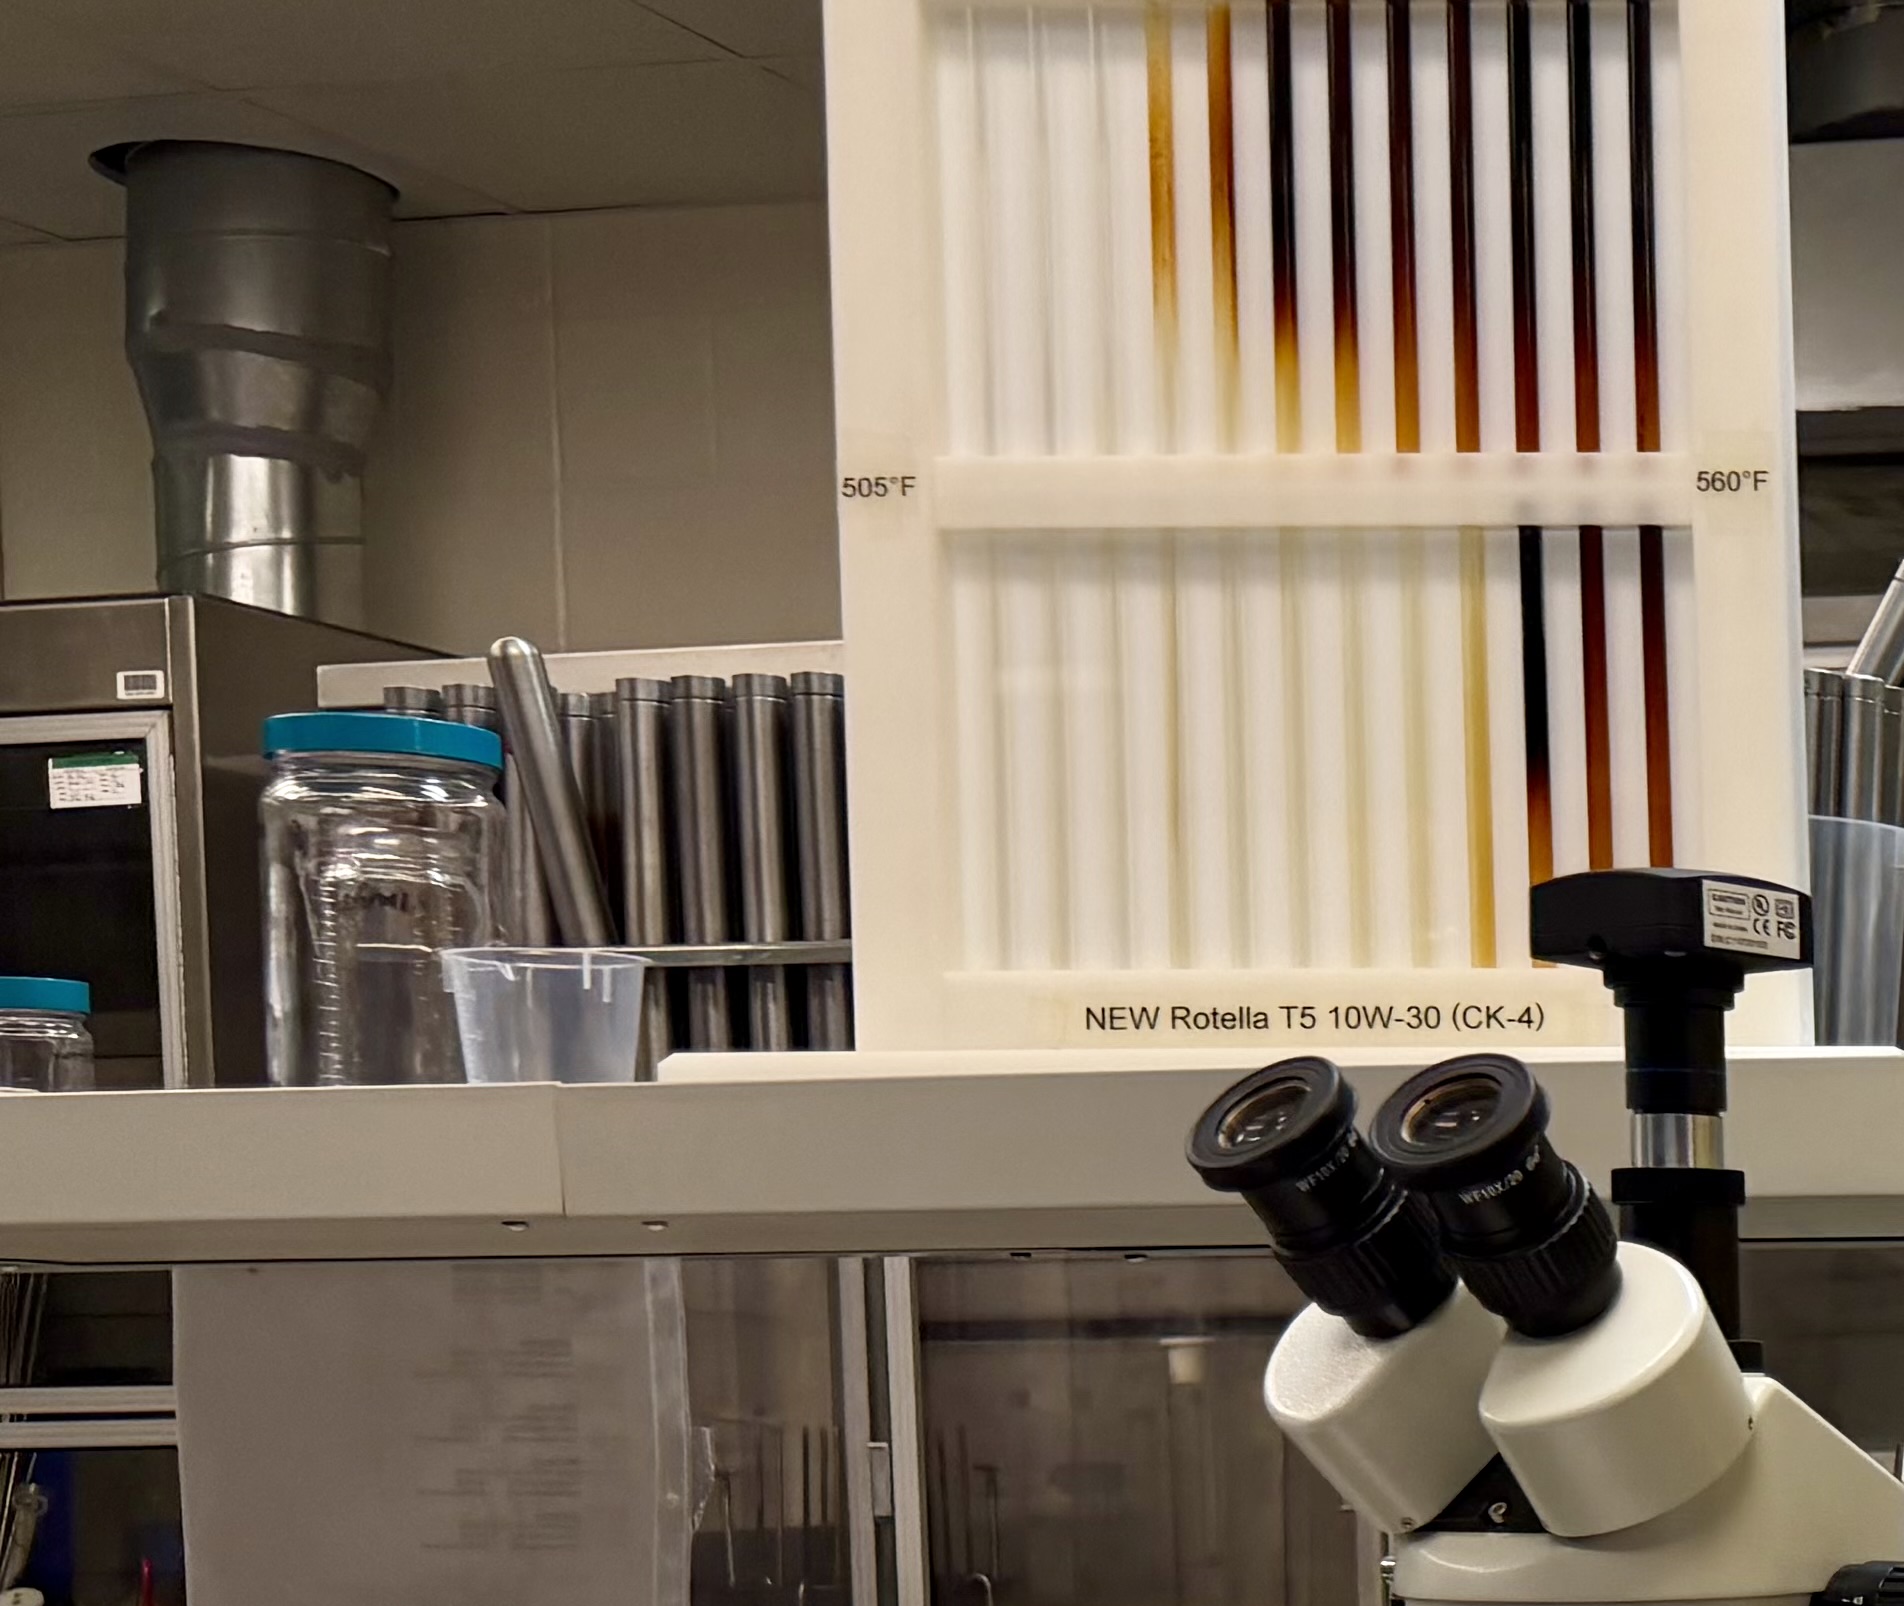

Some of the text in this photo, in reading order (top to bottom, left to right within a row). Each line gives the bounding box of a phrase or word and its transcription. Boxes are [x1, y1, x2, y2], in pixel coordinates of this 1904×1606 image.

[841, 475, 916, 499] 505°F
[1696, 470, 1769, 492] 560°F
[1085, 1000, 1545, 1034] NEW Rotella T5 10W-30 (CK-4)
